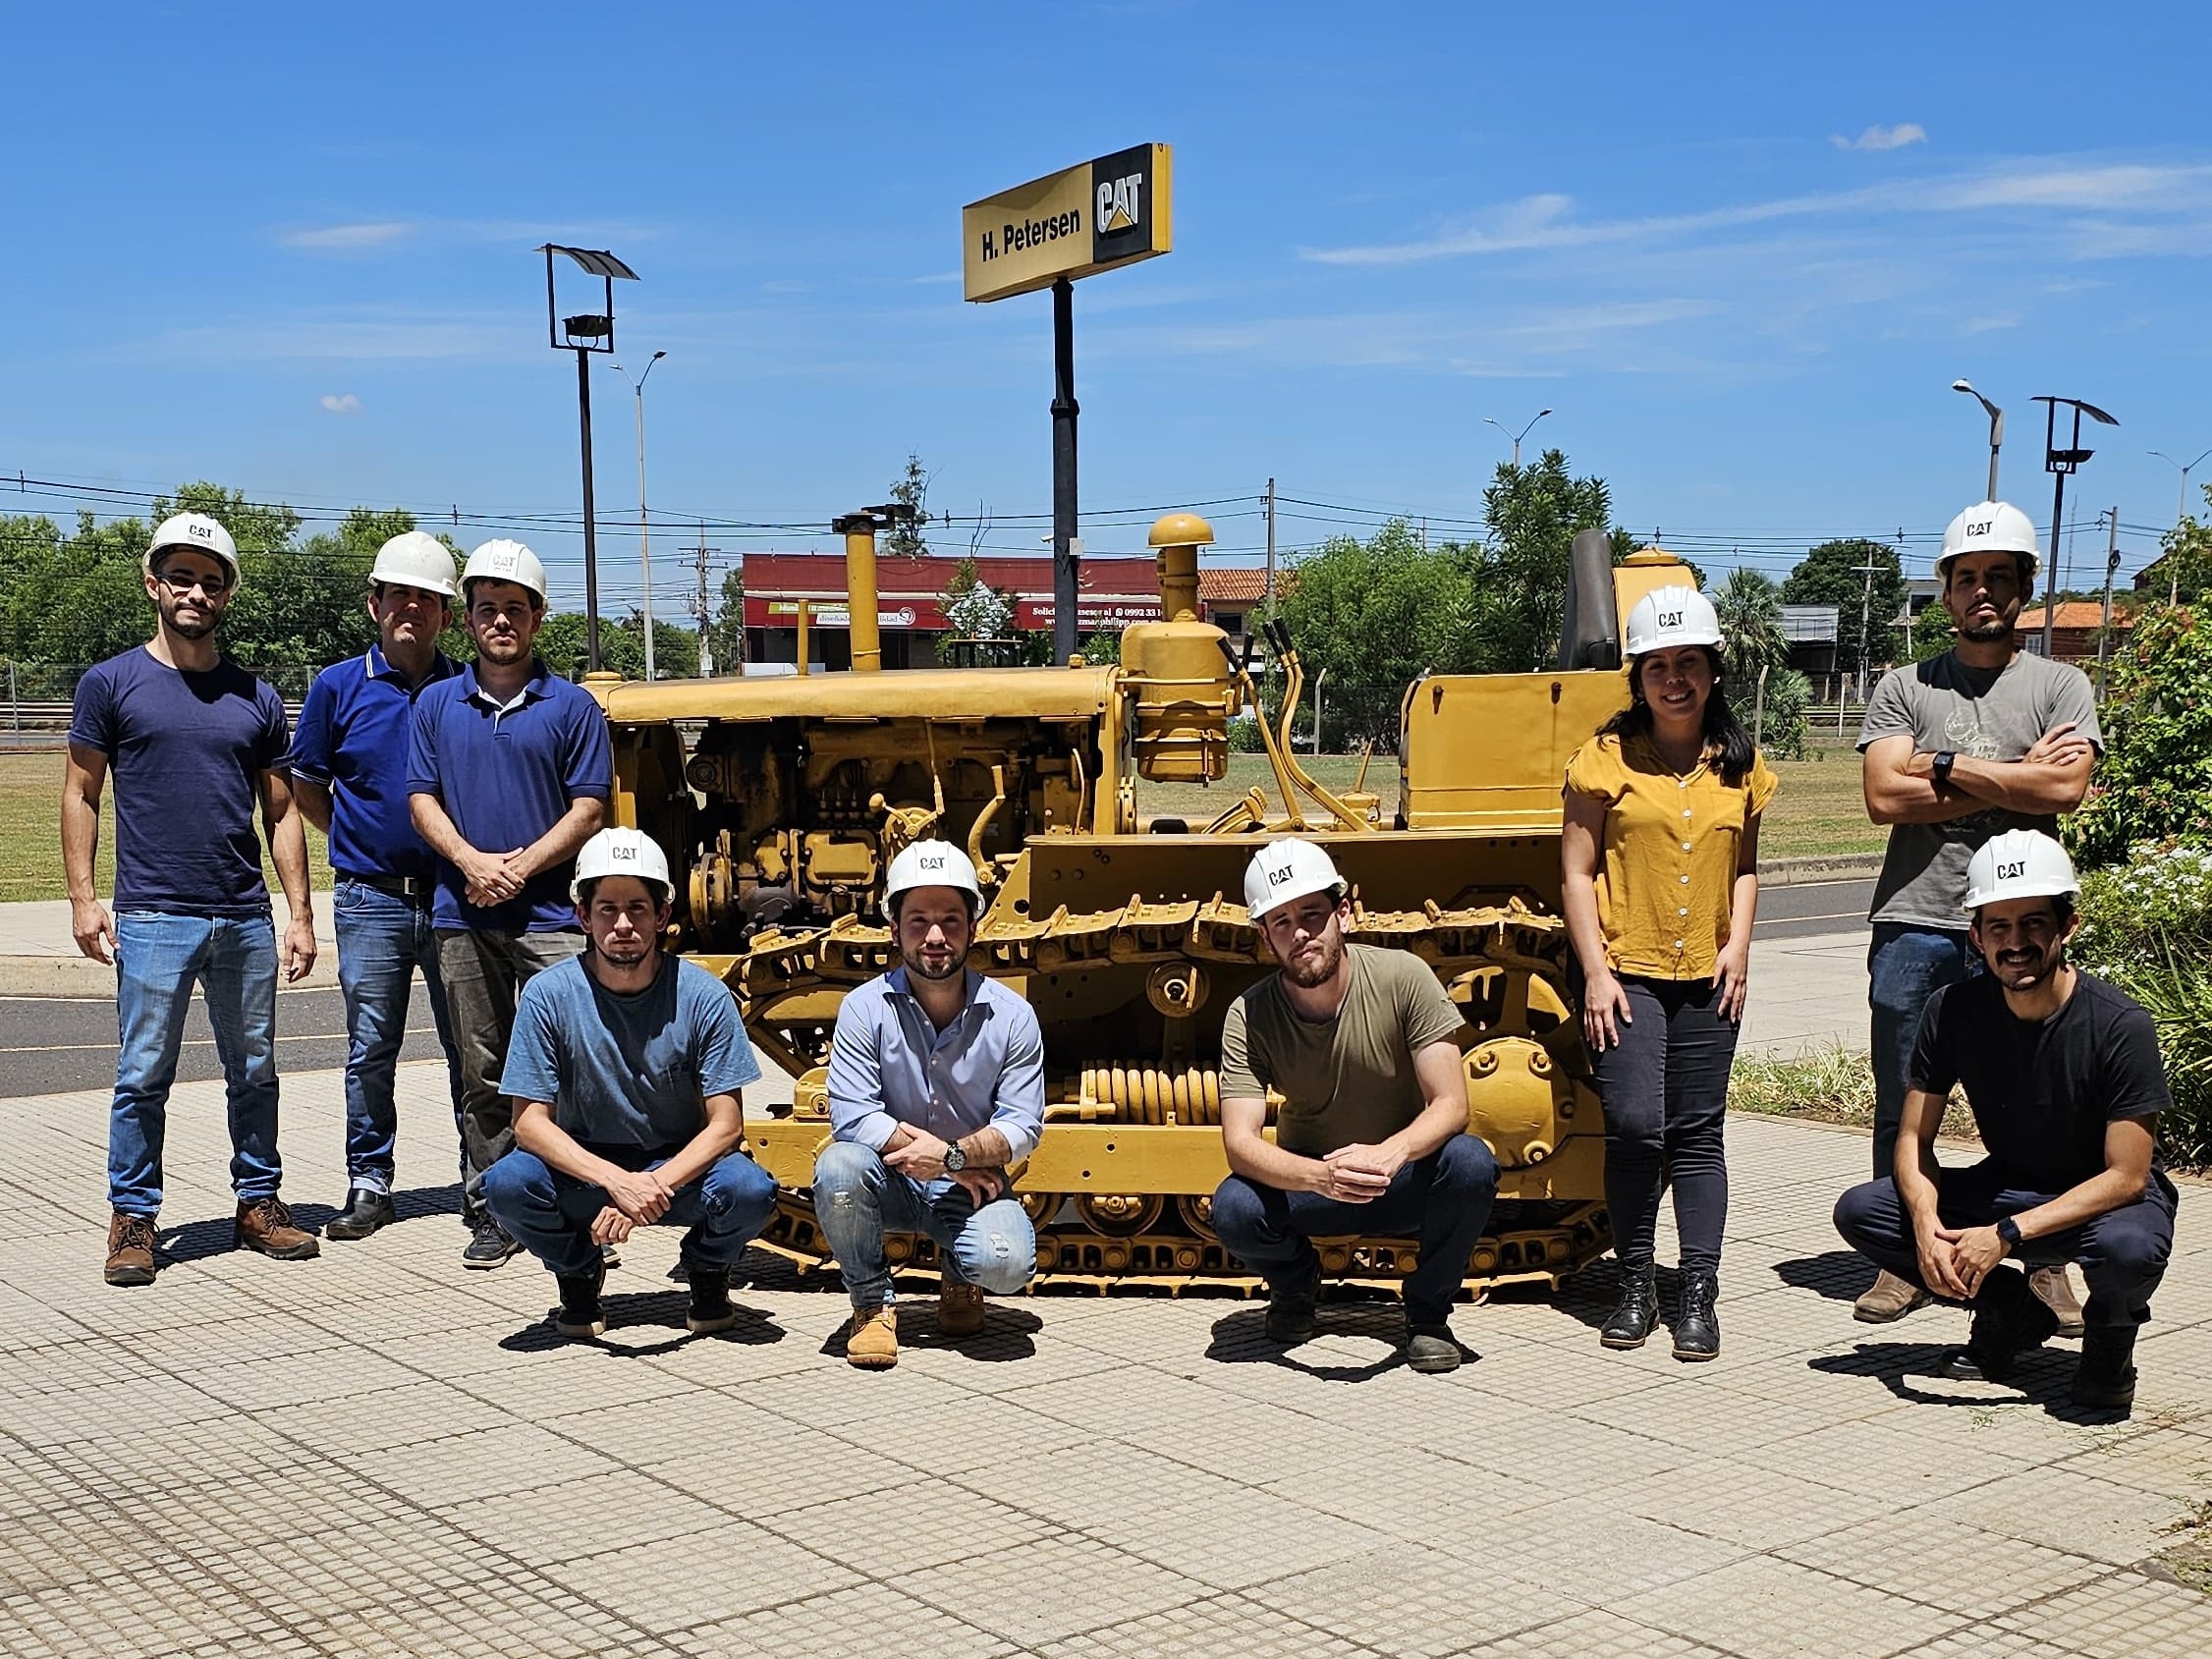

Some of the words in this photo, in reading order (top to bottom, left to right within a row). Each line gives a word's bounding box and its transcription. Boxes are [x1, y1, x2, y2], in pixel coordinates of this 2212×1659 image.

[1097, 173, 1142, 233] CAT
[982, 231, 999, 262] H.
[1004, 208, 1080, 254] Petersen
[190, 525, 213, 539] CAT
[1966, 521, 1993, 536] CAT
[493, 554, 517, 567] CAT
[1659, 611, 1683, 628] CAT
[613, 847, 637, 859] CAT
[920, 857, 945, 869] CAT
[1997, 861, 2025, 879] CAT
[1269, 864, 1293, 886] CAT
